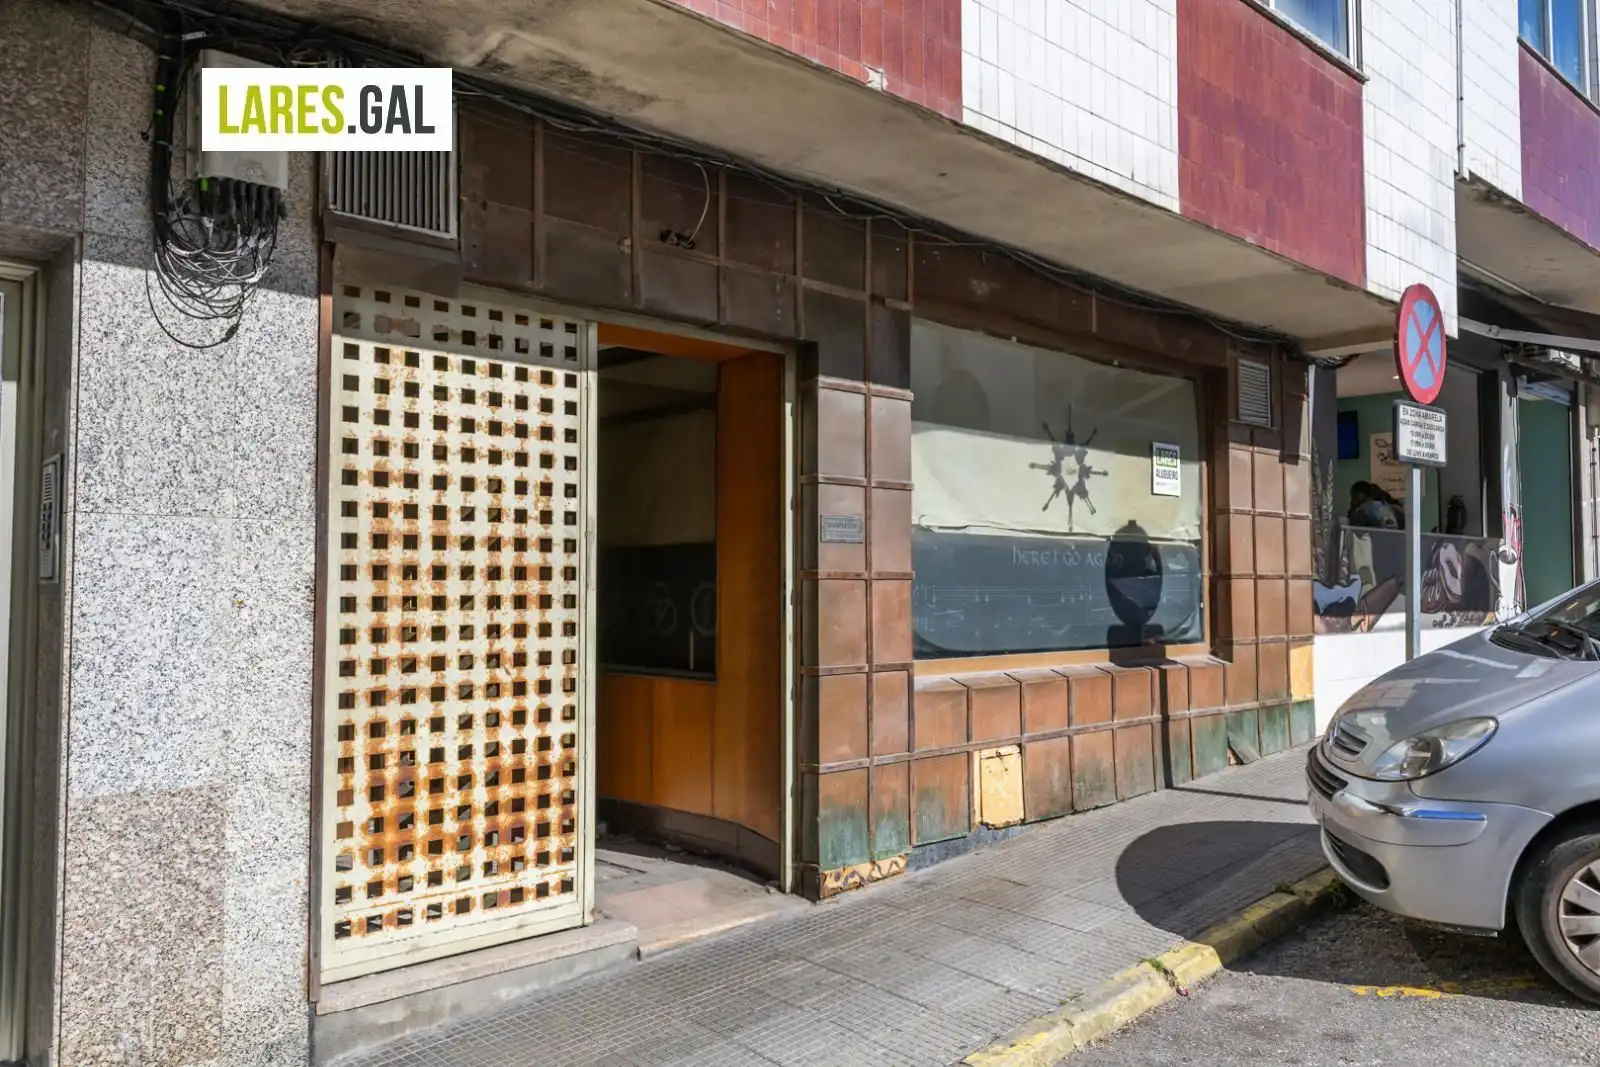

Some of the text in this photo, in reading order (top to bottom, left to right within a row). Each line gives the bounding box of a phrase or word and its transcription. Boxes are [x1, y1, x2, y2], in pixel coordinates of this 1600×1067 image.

[1402, 407, 1442, 422] EN ZONA AMARELA
[1156, 449, 1177, 466] LARES
